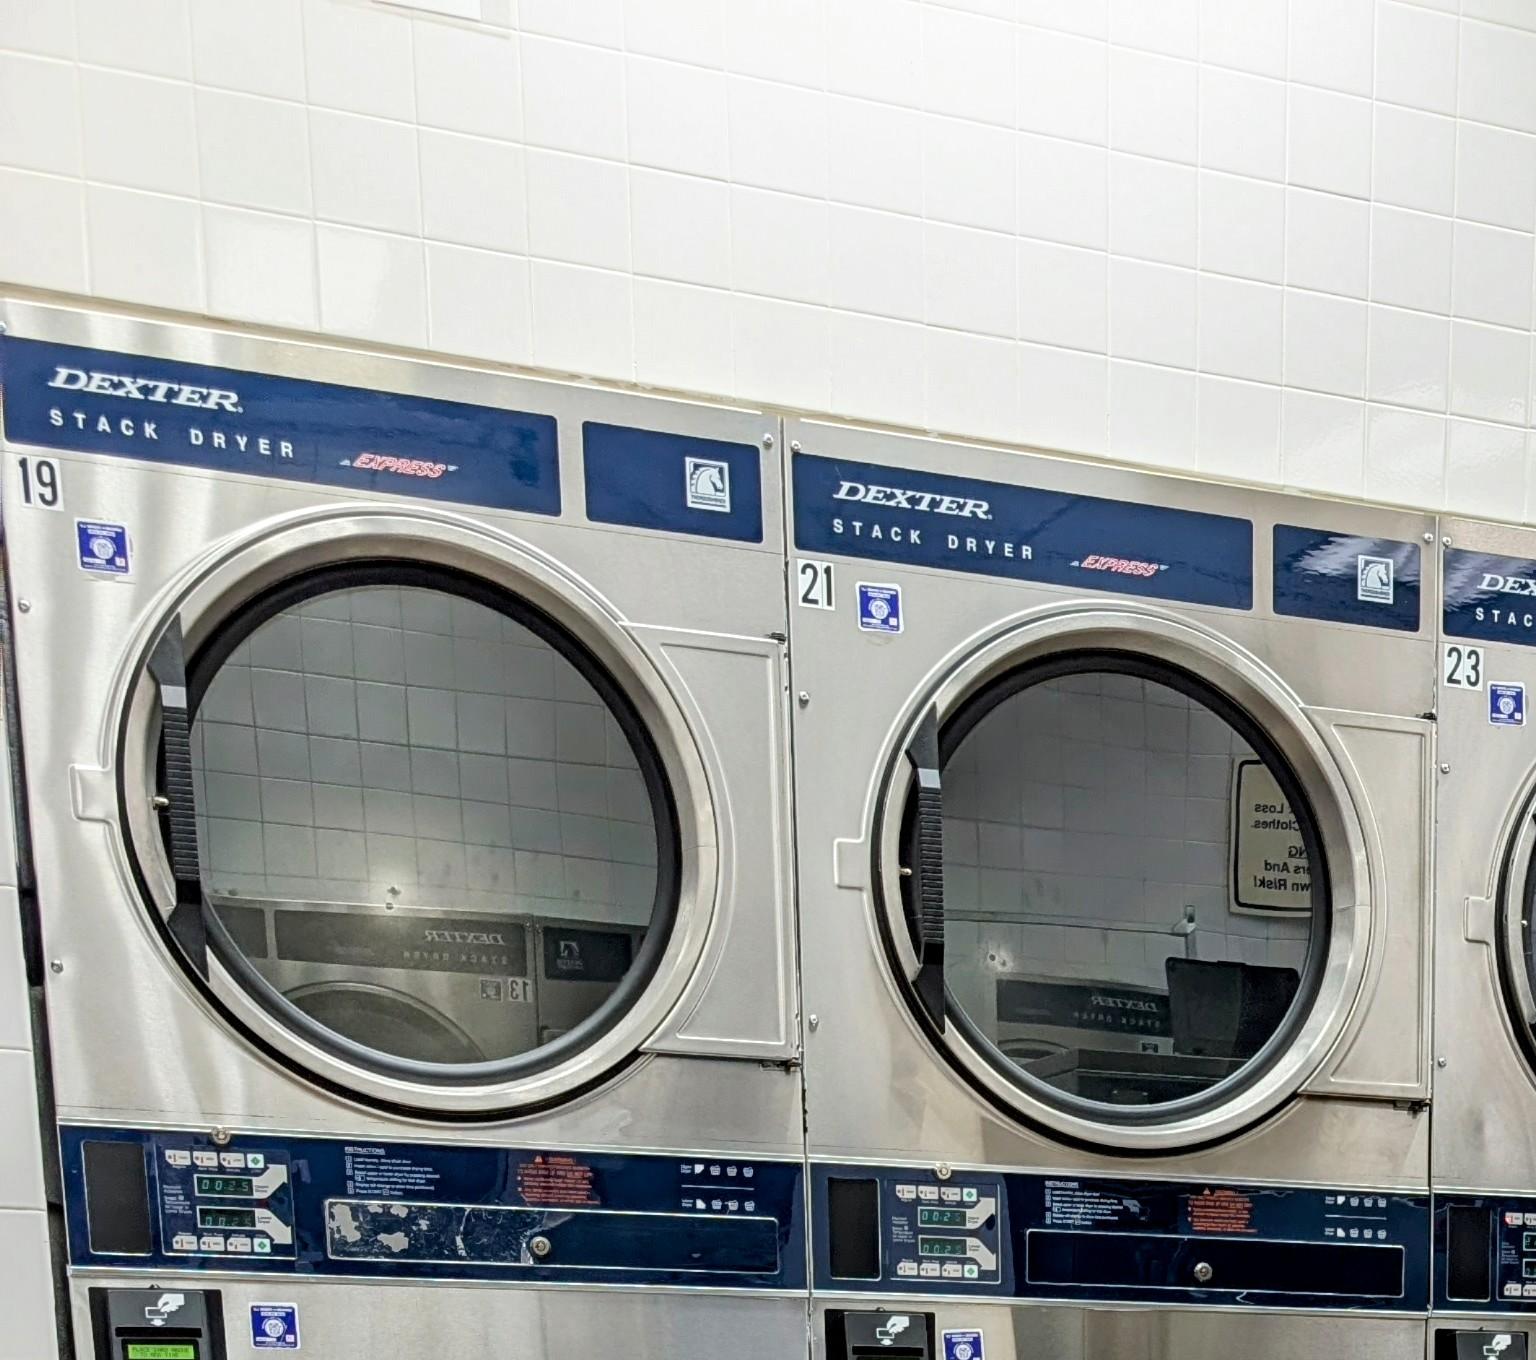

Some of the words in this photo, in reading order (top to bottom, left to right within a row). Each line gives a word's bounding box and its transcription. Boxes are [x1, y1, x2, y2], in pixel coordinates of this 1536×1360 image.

[48, 367, 240, 413] DEXTER
[50, 408, 158, 440] STACK
[190, 428, 293, 458] DRYER
[18, 457, 58, 506] 19
[353, 453, 446, 479] EXPRESS
[833, 481, 991, 520] DEXTER
[833, 518, 921, 545] STACK
[948, 534, 1032, 560] DRYER
[801, 562, 833, 608] 21
[1080, 554, 1159, 577] EXPRESS
[1446, 646, 1480, 687] 23
